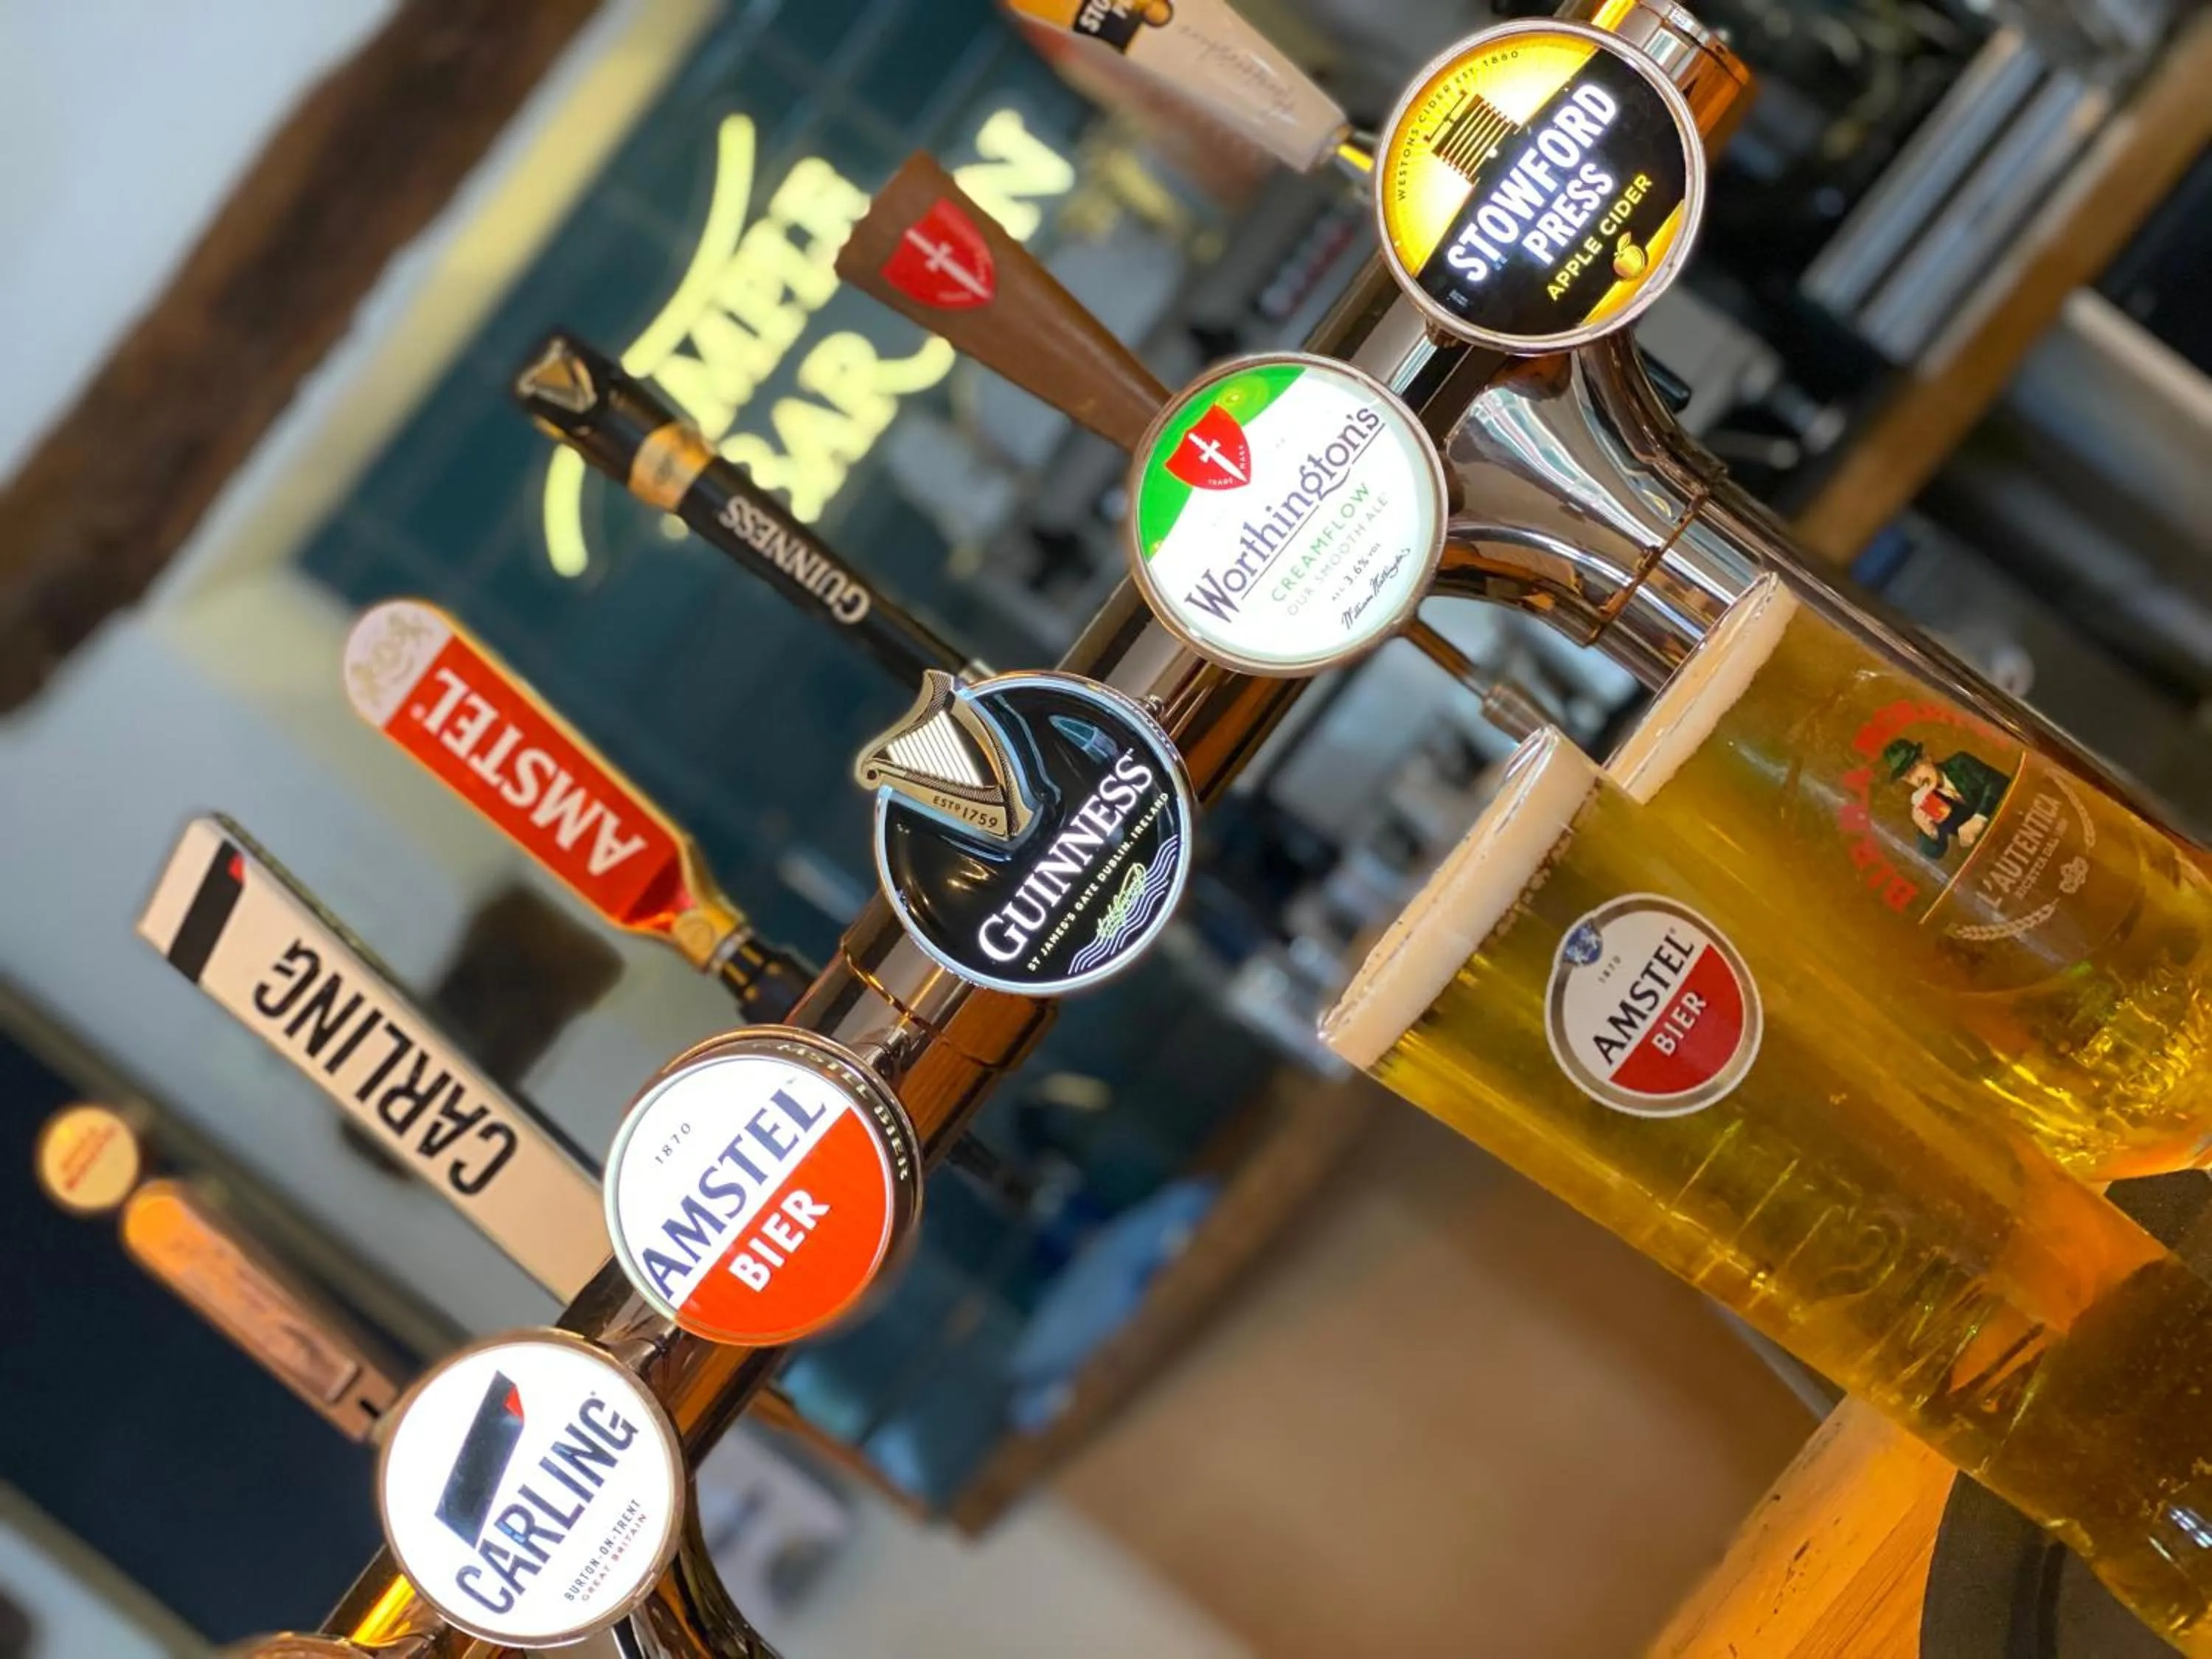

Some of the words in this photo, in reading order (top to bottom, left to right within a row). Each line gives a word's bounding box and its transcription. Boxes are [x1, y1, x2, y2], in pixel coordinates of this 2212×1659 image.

[1398, 129, 1419, 201] WESTONS
[1419, 85, 1451, 123] CIDER
[1446, 83, 1617, 282] STOWFORD
[1522, 164, 1613, 265] PRESS
[1547, 233, 1602, 300] APPLE
[1601, 173, 1653, 236] CIDER
[718, 495, 871, 624] GUINNESS
[1185, 408, 1379, 623] Worthington's
[1271, 482, 1368, 602] CREAMFLOW
[422, 667, 647, 876] AMSTEL
[961, 807, 998, 829] 1759
[978, 754, 1153, 961] GUINNESS
[1026, 956, 1040, 972] ST
[1040, 911, 1076, 956] JAMES'S
[1074, 883, 1099, 911] GATE
[1130, 792, 1169, 838] IRELAND
[1976, 793, 2062, 909] L'AUTENTICA
[1593, 933, 1694, 1065] AMSTEL
[1652, 991, 1707, 1057] BIER
[254, 939, 518, 1196] CARLING
[641, 1089, 827, 1300] AMSTEL
[653, 1122, 692, 1164] 1870
[728, 1189, 830, 1293] BIER
[456, 1397, 639, 1615] CARLING
